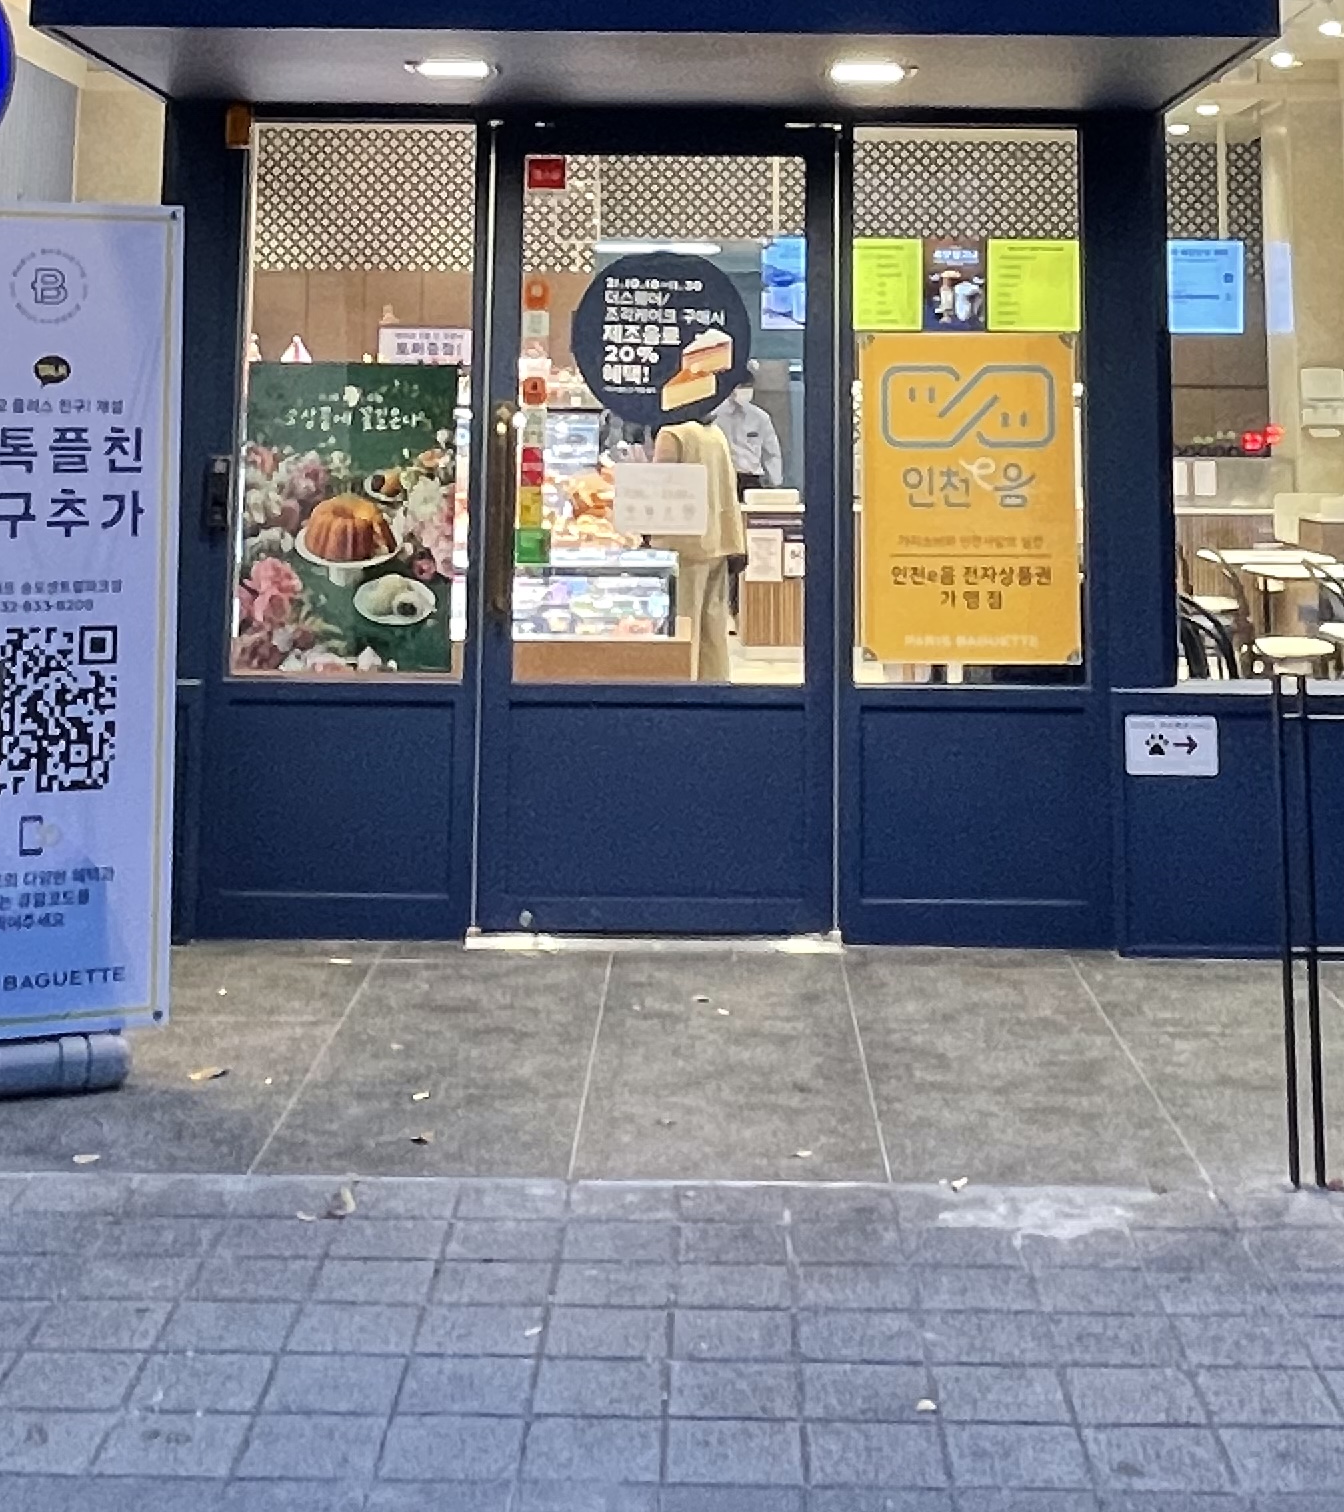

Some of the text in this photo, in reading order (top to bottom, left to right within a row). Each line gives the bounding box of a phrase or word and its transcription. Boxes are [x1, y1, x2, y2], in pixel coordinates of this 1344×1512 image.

[602, 324, 682, 346] 제조음료
[604, 344, 660, 364] 20%
[2, 966, 126, 992] BAGUETTE
